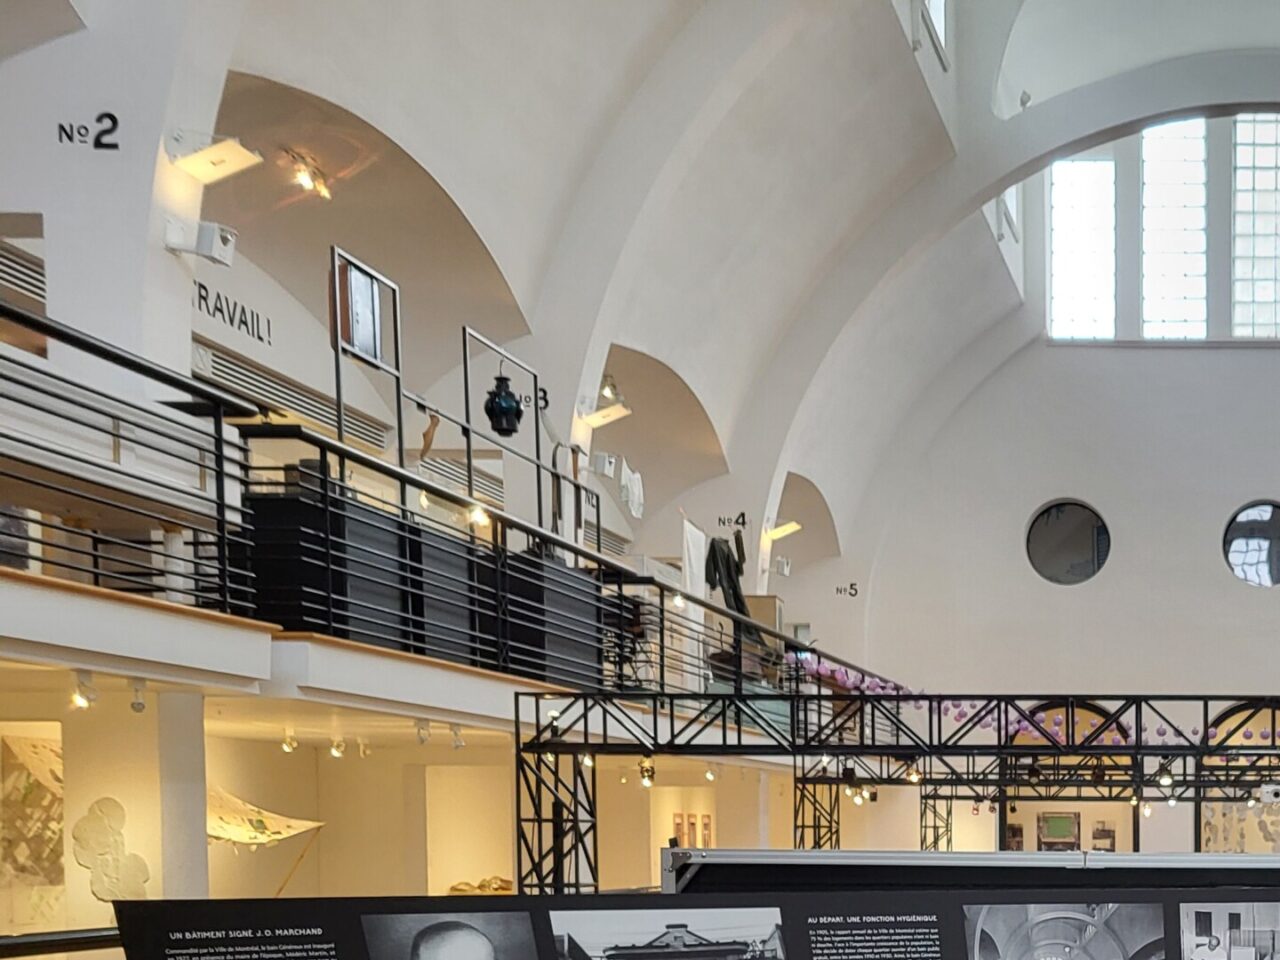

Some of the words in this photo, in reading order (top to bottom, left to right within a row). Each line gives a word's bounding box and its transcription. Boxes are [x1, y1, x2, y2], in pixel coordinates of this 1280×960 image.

[193, 279, 273, 346] RAVAIL!
[862, 915, 895, 923] FONCTION
[169, 931, 183, 940] UN
[275, 927, 323, 937] MARCHAND
